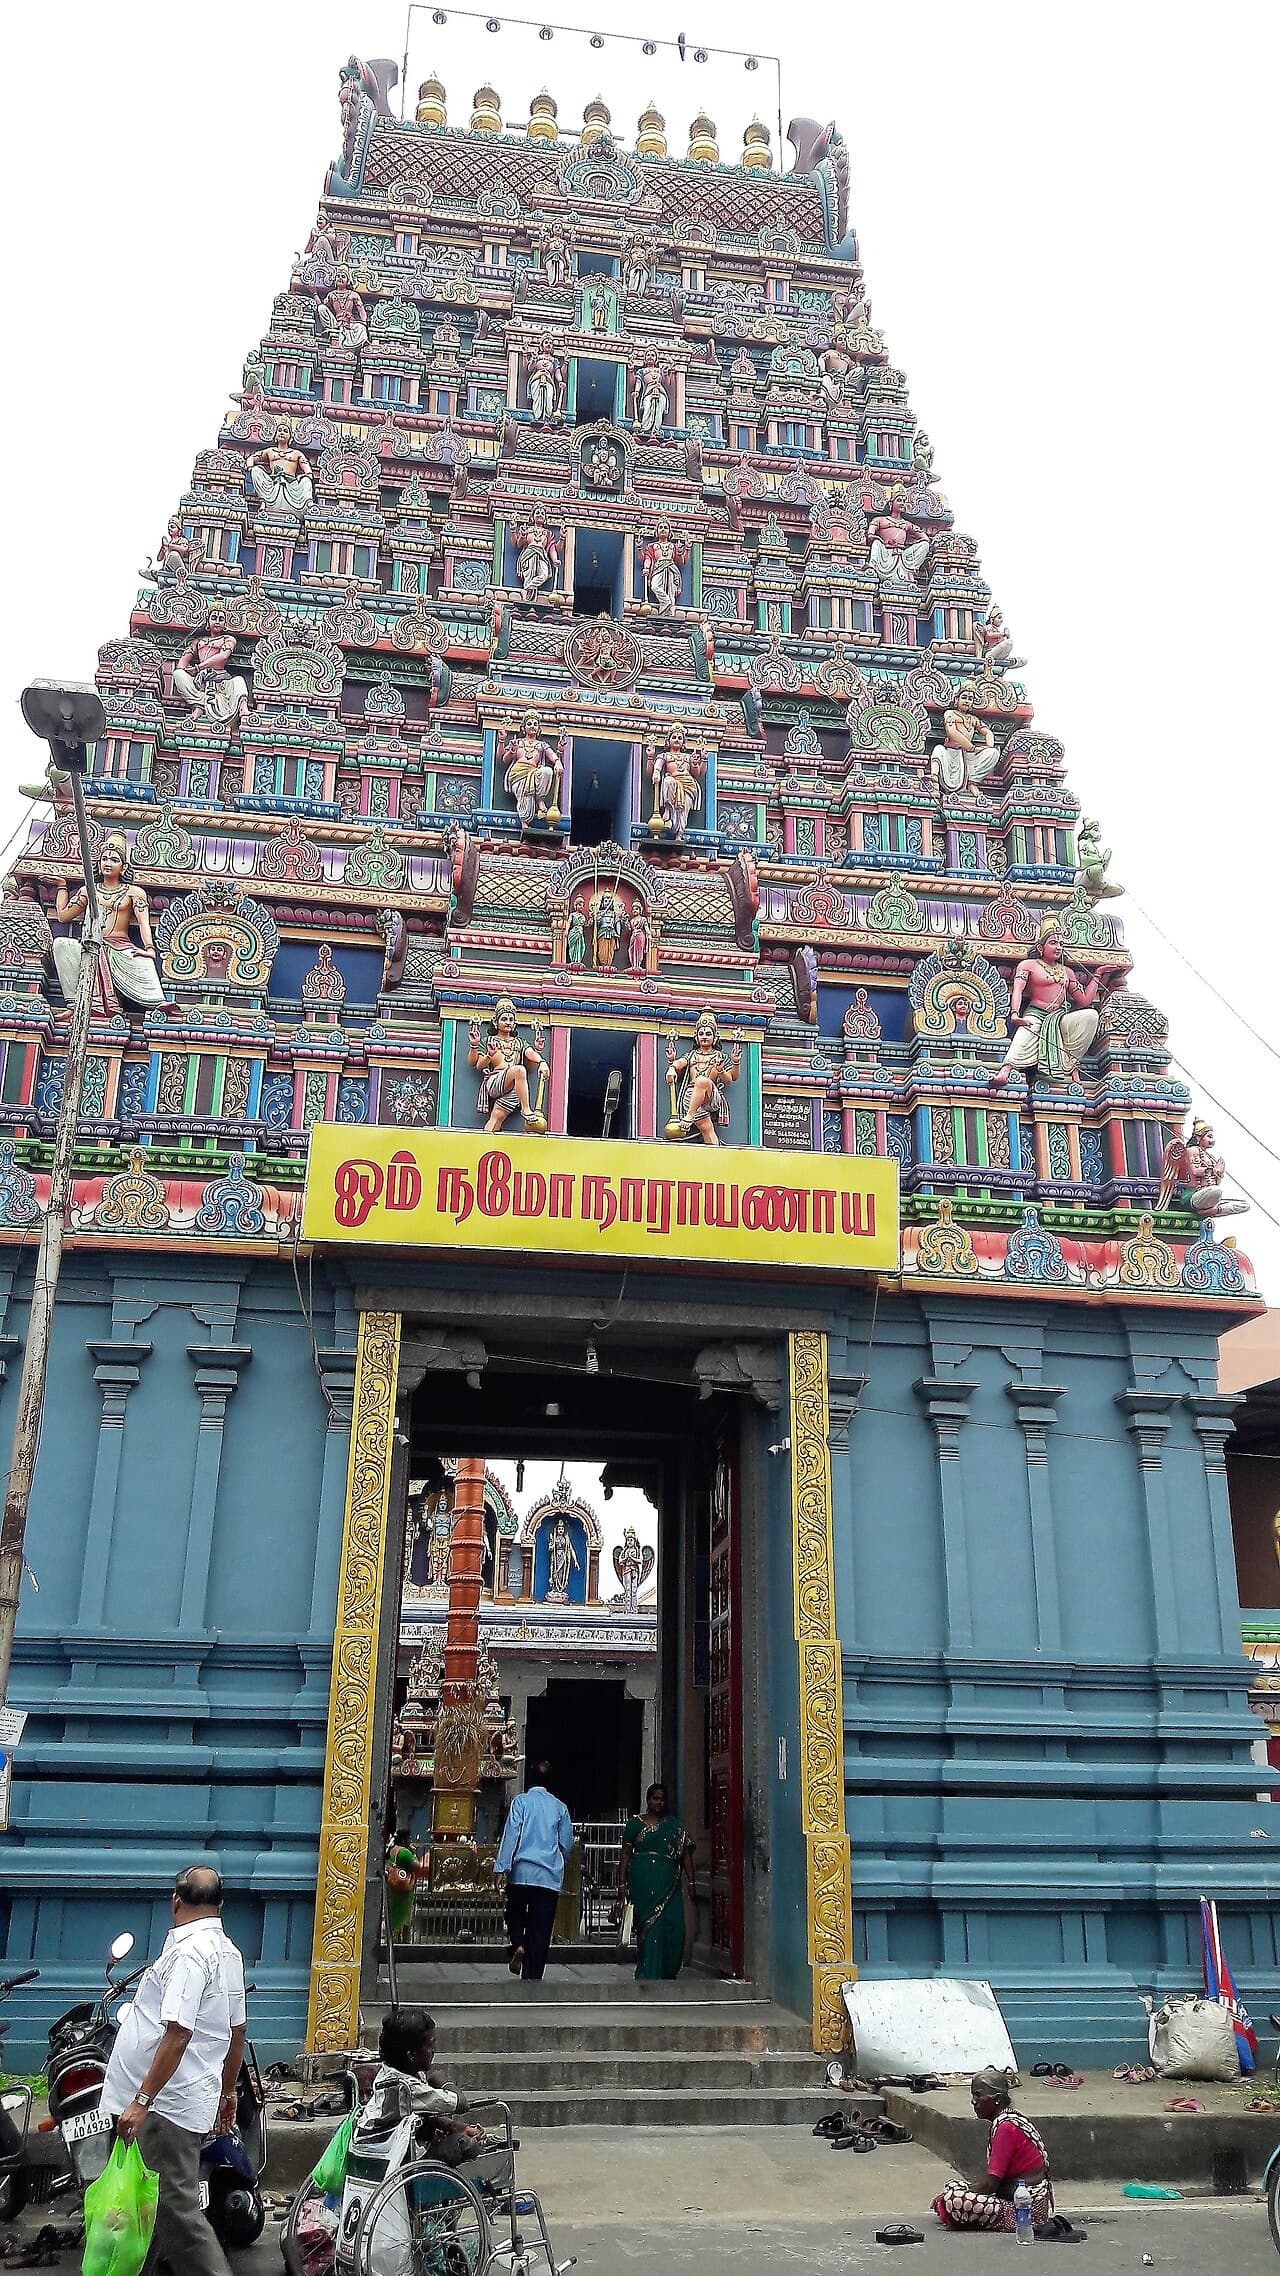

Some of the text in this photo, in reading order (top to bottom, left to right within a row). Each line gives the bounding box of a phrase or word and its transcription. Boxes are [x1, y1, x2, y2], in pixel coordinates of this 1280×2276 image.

[334, 1150, 421, 1228] ஓம்
[75, 2110, 100, 2127] PY 01
